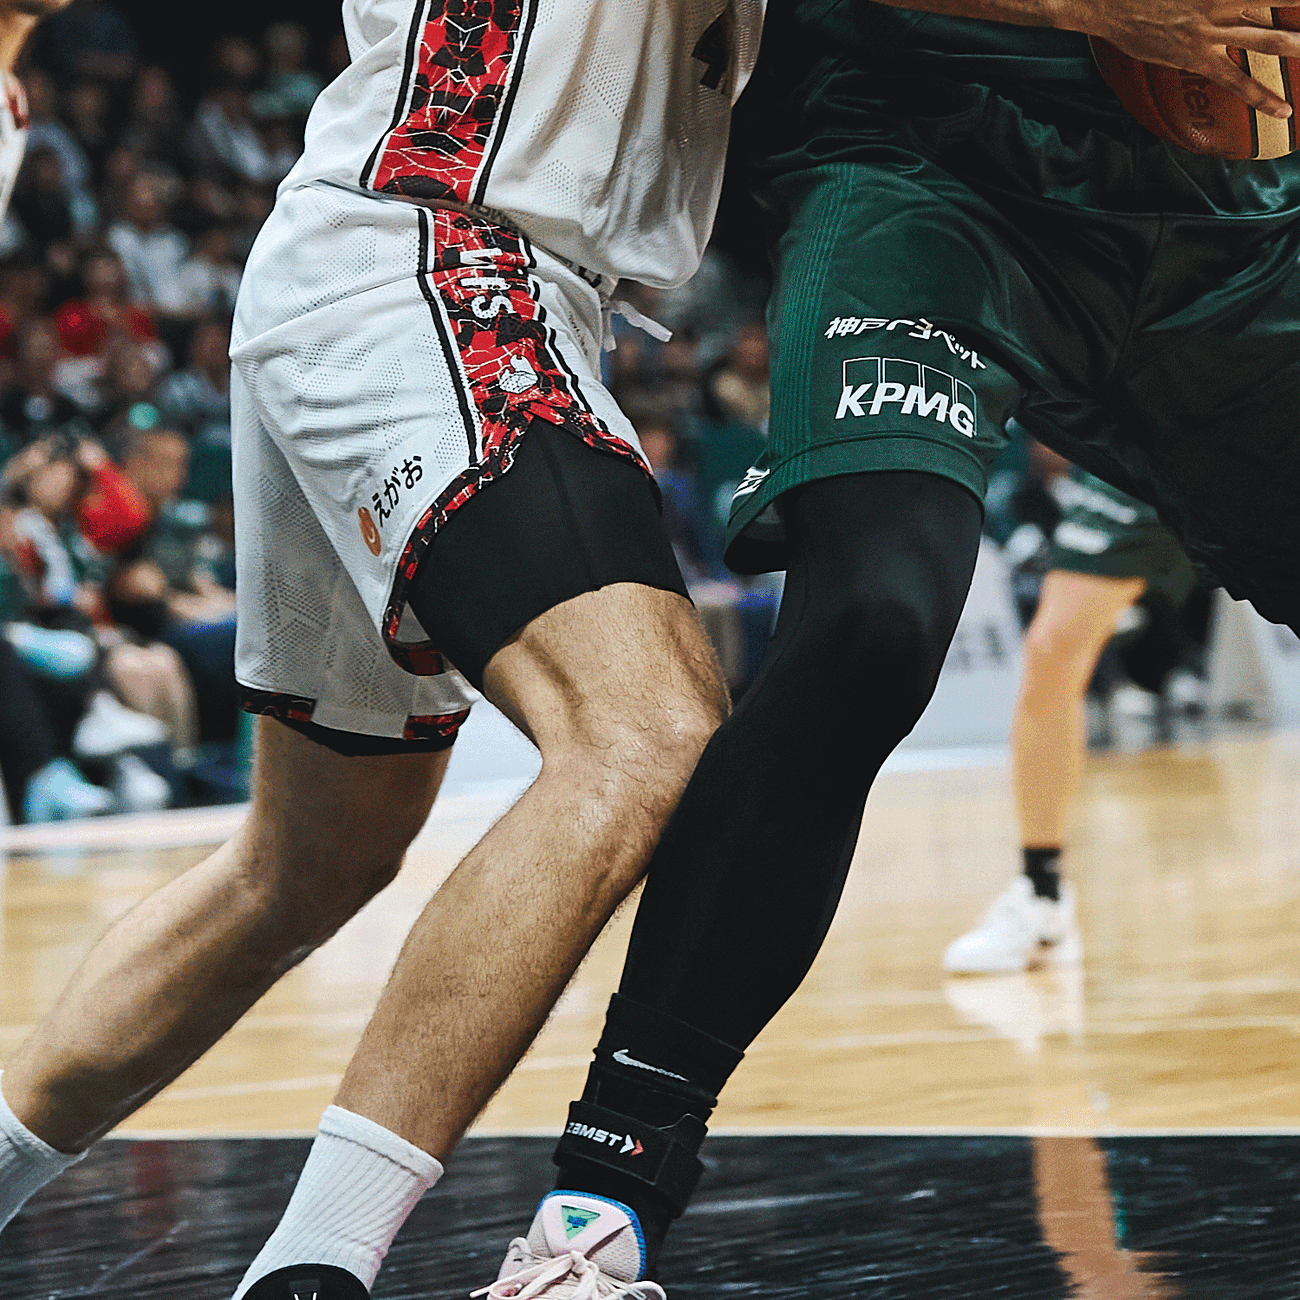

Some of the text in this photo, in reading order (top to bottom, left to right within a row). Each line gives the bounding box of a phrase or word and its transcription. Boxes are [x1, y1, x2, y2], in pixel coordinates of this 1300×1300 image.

[835, 382, 975, 439] KPMG
[371, 456, 423, 528] えがお
